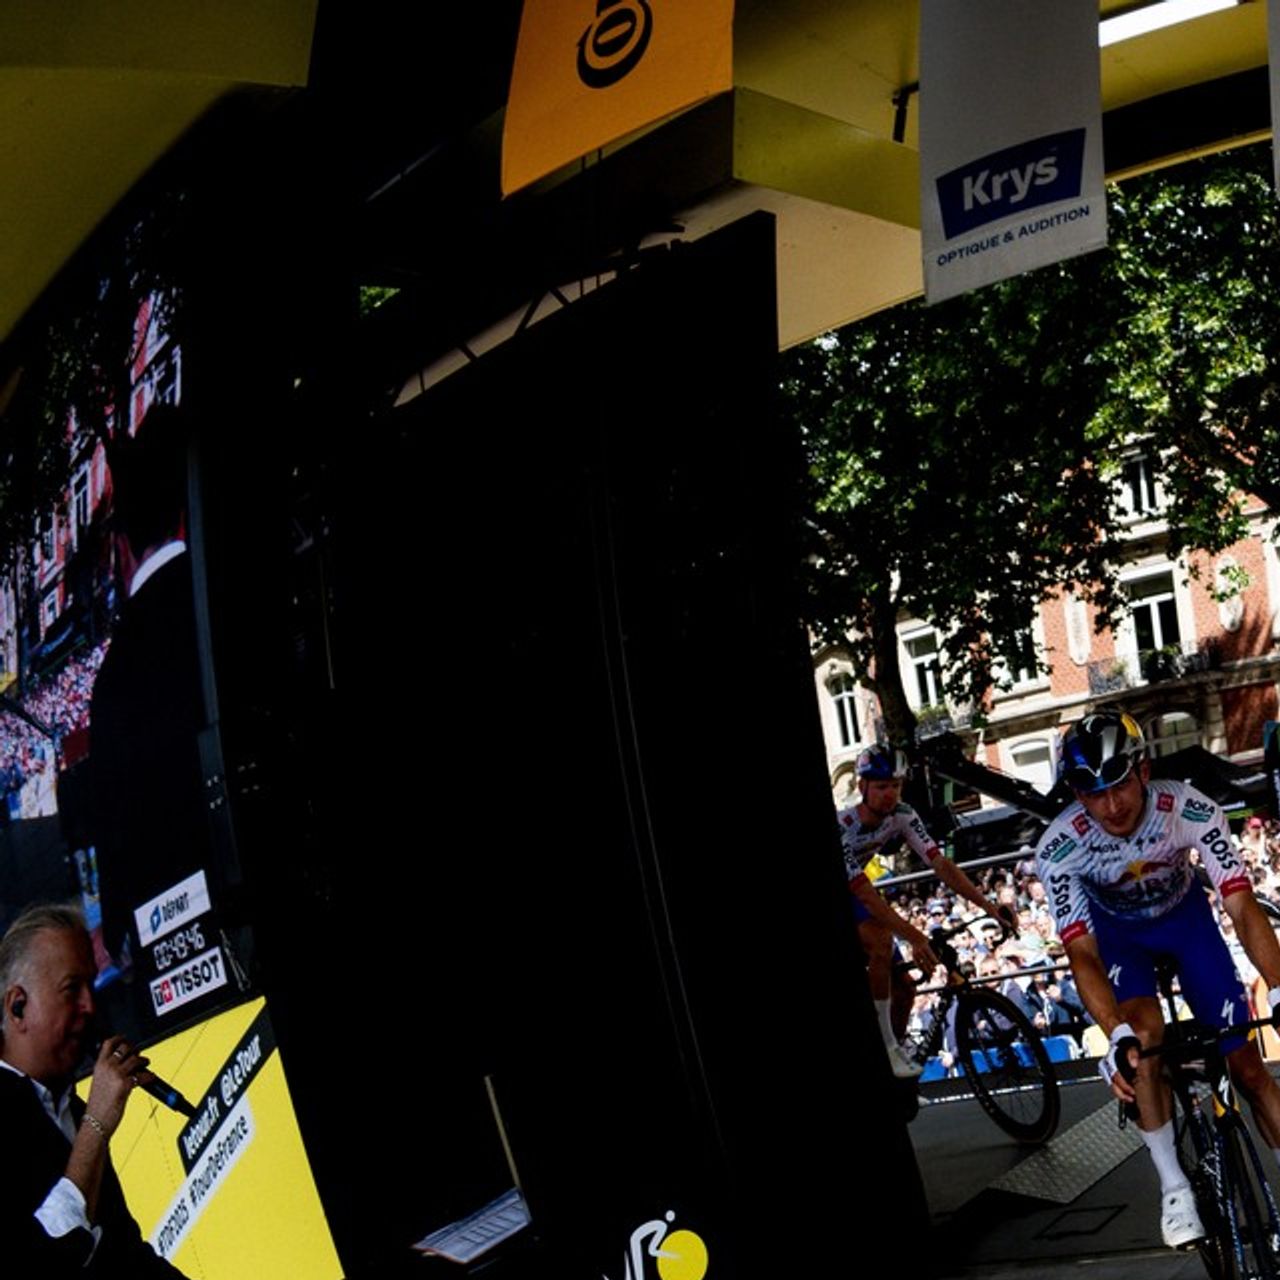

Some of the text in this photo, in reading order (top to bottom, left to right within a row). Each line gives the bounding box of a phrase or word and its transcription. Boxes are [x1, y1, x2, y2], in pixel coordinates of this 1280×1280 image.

[962, 150, 1059, 212] Krys
[937, 205, 1090, 266] OPTIQUE & AUDITION
[1184, 798, 1215, 814] BORA
[1040, 832, 1070, 862] BORA
[1201, 827, 1238, 870] BOSS
[1051, 873, 1071, 918] BOSS
[171, 953, 223, 999] TISSOT
